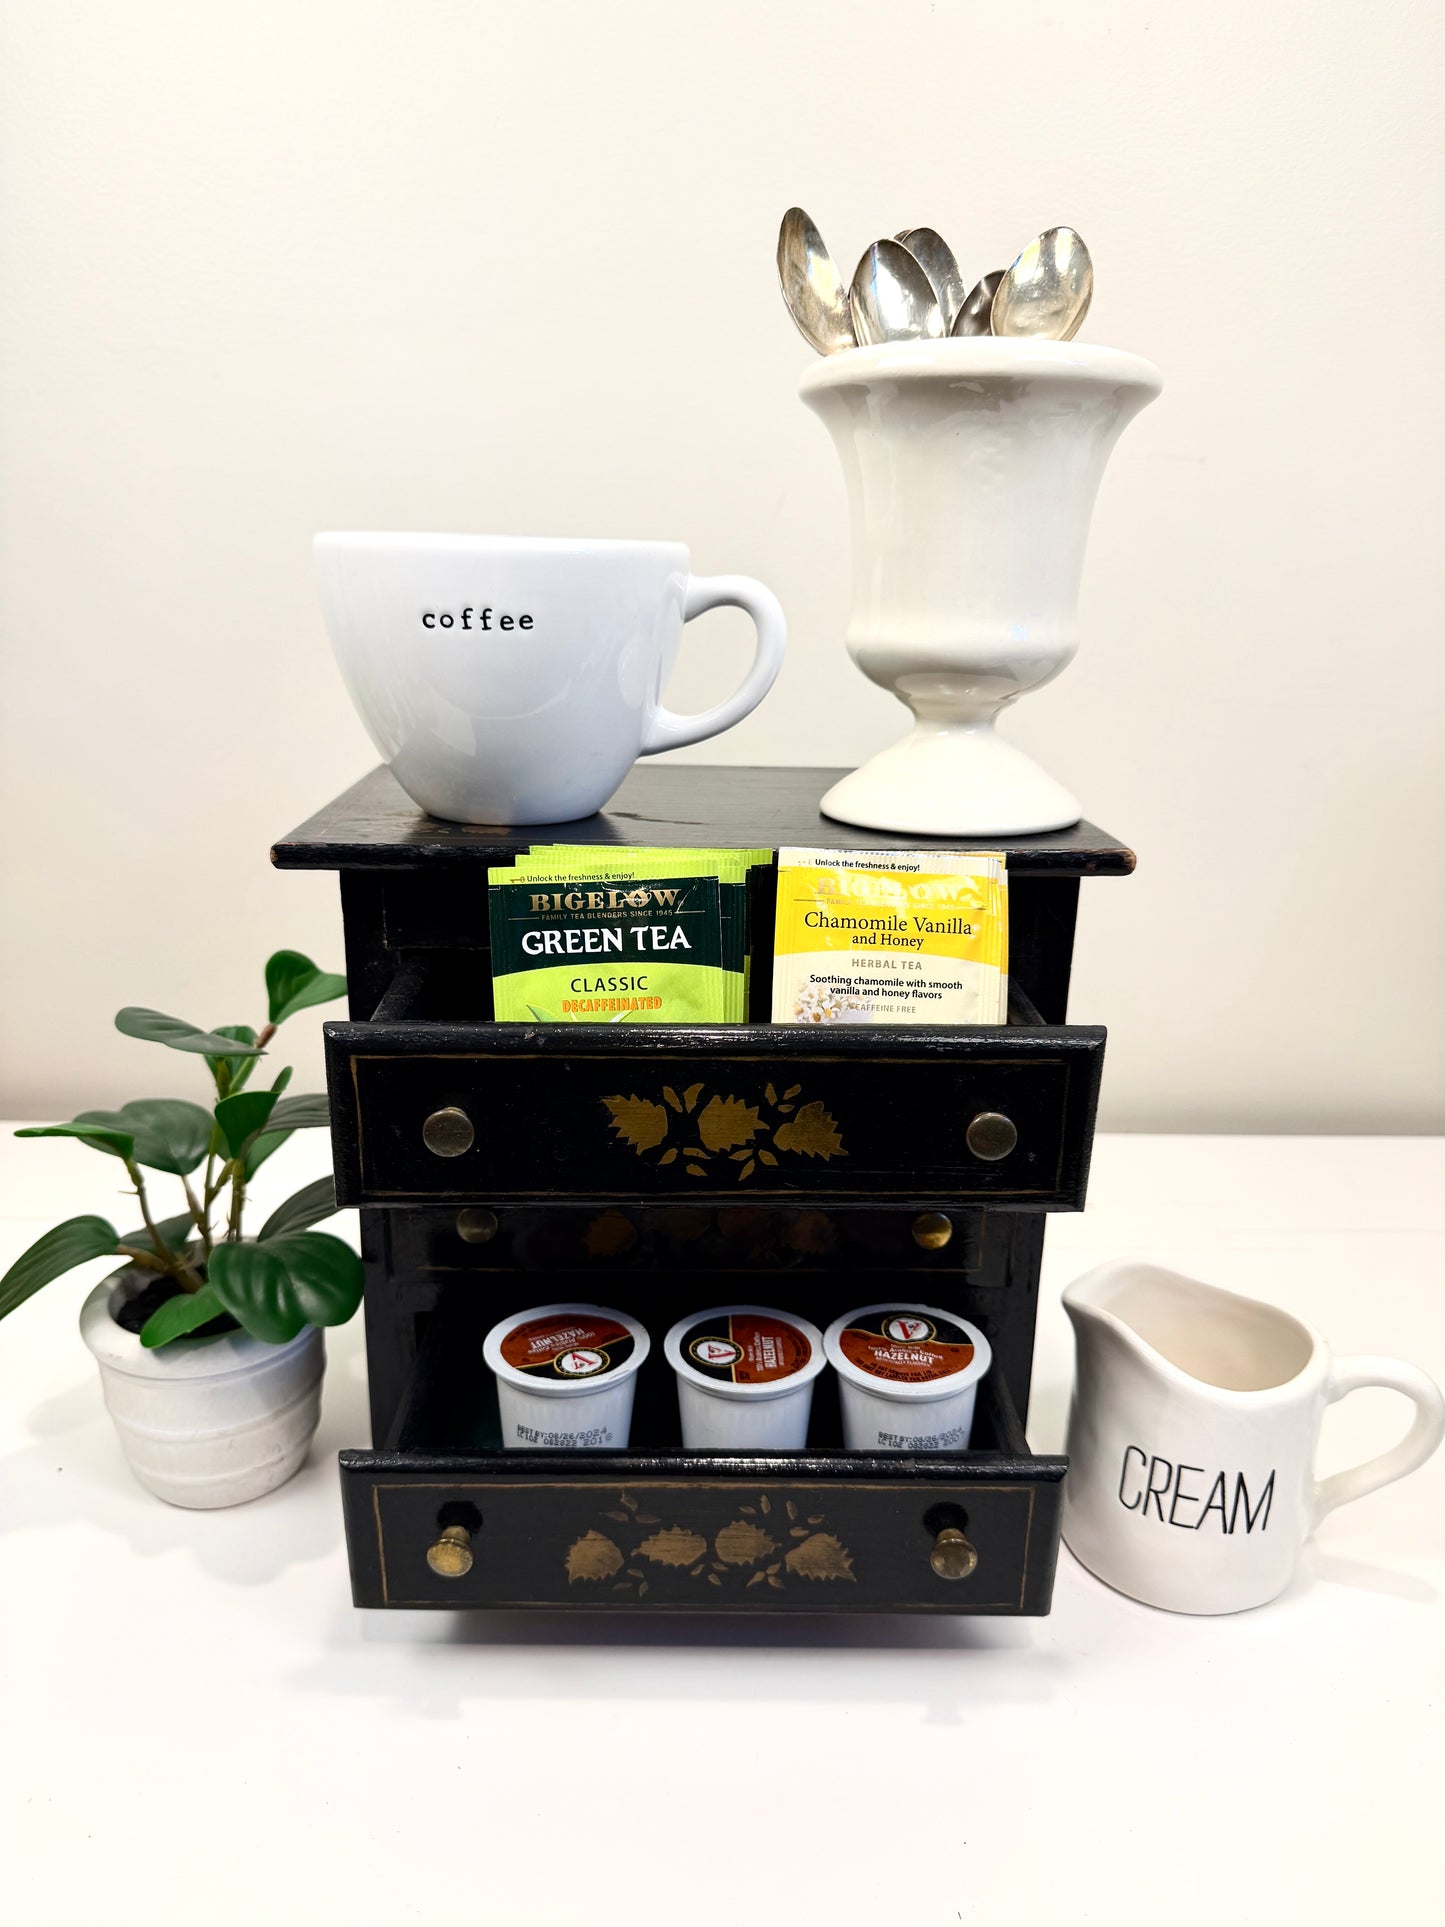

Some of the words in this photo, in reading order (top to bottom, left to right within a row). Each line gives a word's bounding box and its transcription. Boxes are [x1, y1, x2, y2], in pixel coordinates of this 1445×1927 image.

[422, 608, 534, 631] coffee
[815, 858, 840, 867] Unlock
[841, 860, 854, 868] the
[855, 860, 889, 870] freshness
[890, 862, 896, 870] &
[898, 863, 920, 872] enjoy!
[526, 874, 552, 883] Unlock
[554, 874, 567, 882] the
[568, 873, 603, 882] freshness
[612, 872, 635, 881] enjoy!
[529, 888, 682, 912] BIGELOW
[804, 911, 908, 932] Chamomile
[913, 916, 972, 935] Vanilla
[522, 928, 624, 955] GREEN
[630, 926, 692, 951] TEA
[852, 933, 876, 945] and
[880, 934, 924, 951] Honey
[851, 958, 898, 969] HERBAL
[900, 960, 922, 970] TEA
[570, 976, 649, 993] CLASSIC
[810, 974, 852, 986] Soothing
[854, 976, 905, 988] chamomile
[906, 978, 927, 989] with
[928, 980, 963, 990] smooth
[830, 986, 860, 996] vanilla
[862, 986, 880, 996] and
[882, 988, 910, 1000] honey
[912, 988, 942, 1000] flavors
[562, 996, 662, 1013] DECAFFEINATED
[855, 1004, 894, 1013] CAFFEINE
[896, 1004, 916, 1014] FREE
[530, 1328, 585, 1348] HAZELNUT
[874, 1350, 934, 1364] HAZELNUT
[1119, 1445, 1276, 1534] CREAM
